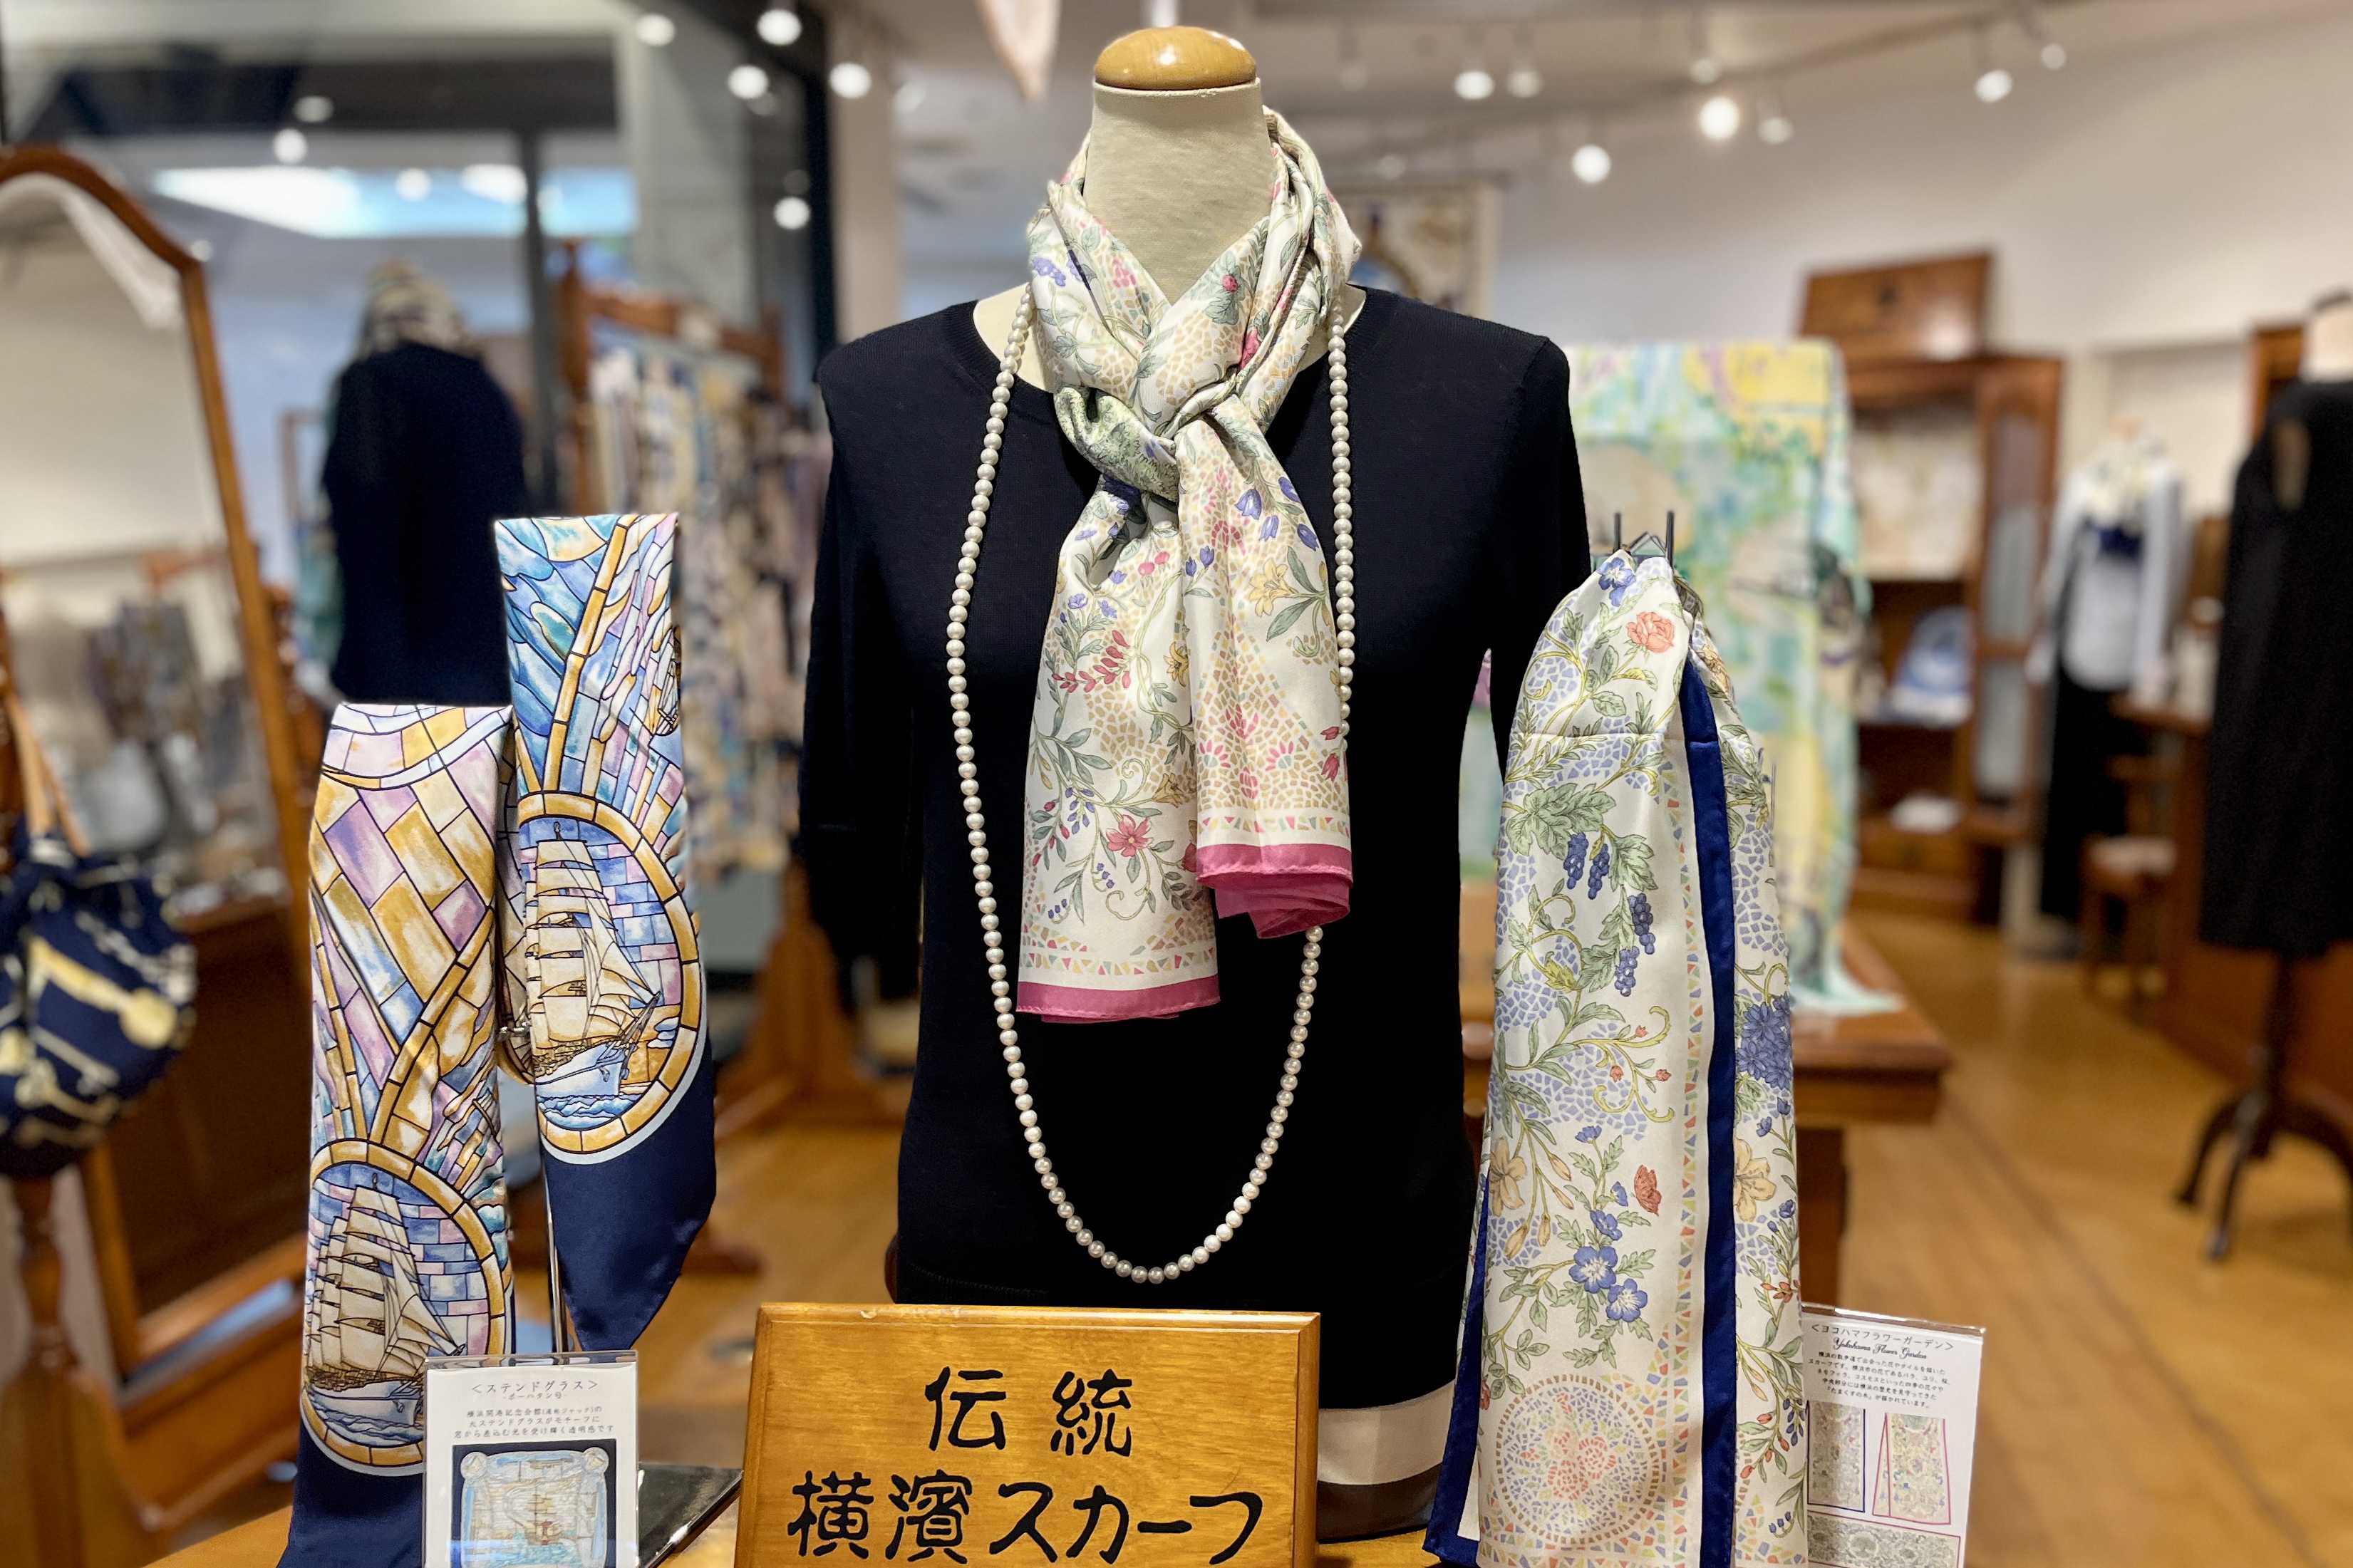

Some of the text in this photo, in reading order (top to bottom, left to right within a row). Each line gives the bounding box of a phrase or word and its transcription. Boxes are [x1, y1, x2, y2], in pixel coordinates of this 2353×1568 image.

[1833, 1337, 1927, 1359] Yokohama Flower Garden
[924, 1366, 1133, 1458] 伝統
[787, 1469, 1265, 1567] 横濱スカーフ
